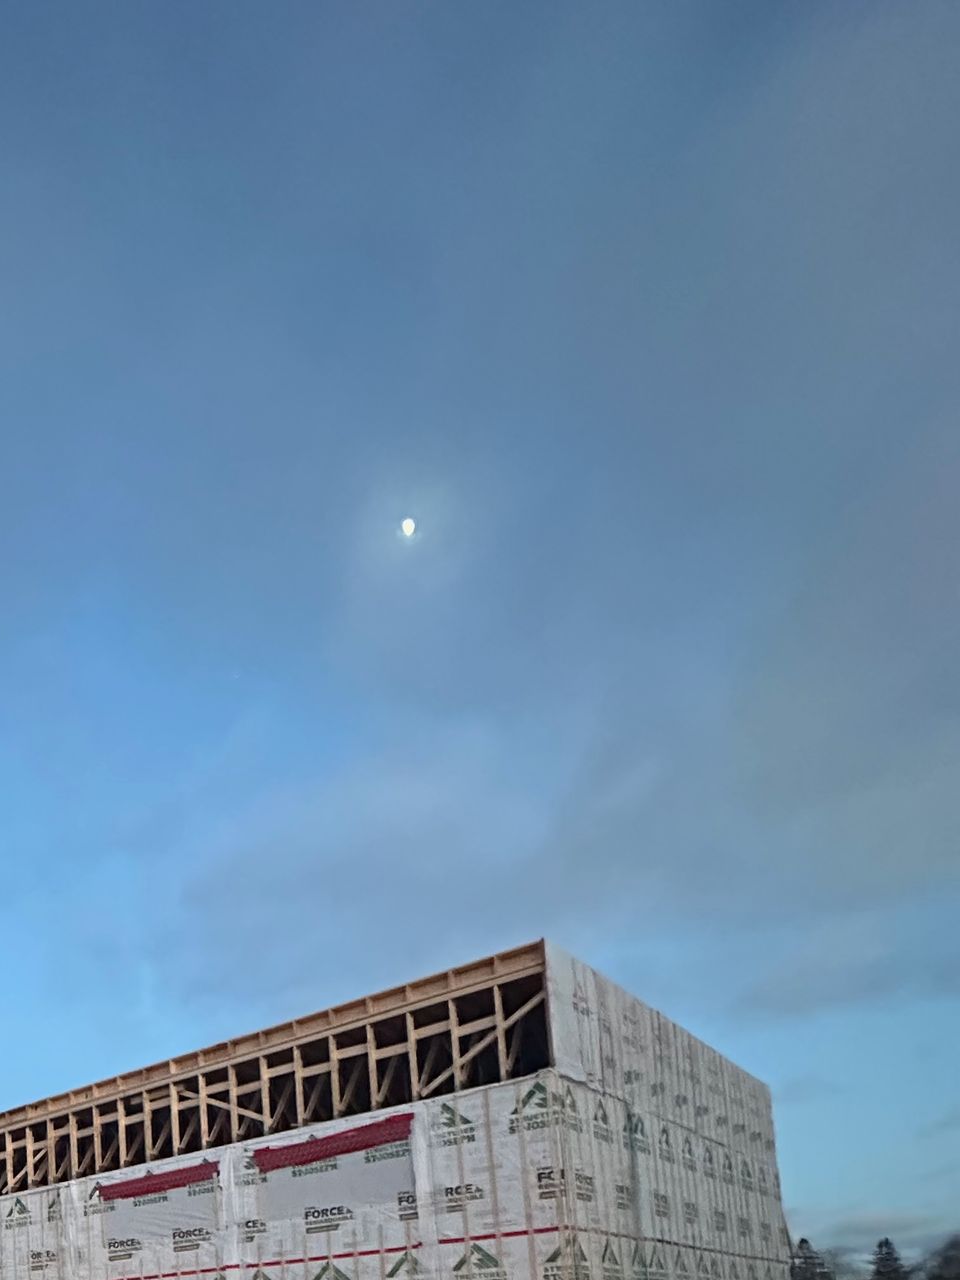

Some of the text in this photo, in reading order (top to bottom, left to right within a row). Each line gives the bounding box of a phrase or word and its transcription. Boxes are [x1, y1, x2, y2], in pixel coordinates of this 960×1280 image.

[305, 1206, 344, 1220] FORCE
[172, 1228, 205, 1240] FORCE
[108, 1239, 136, 1250] FORCE
